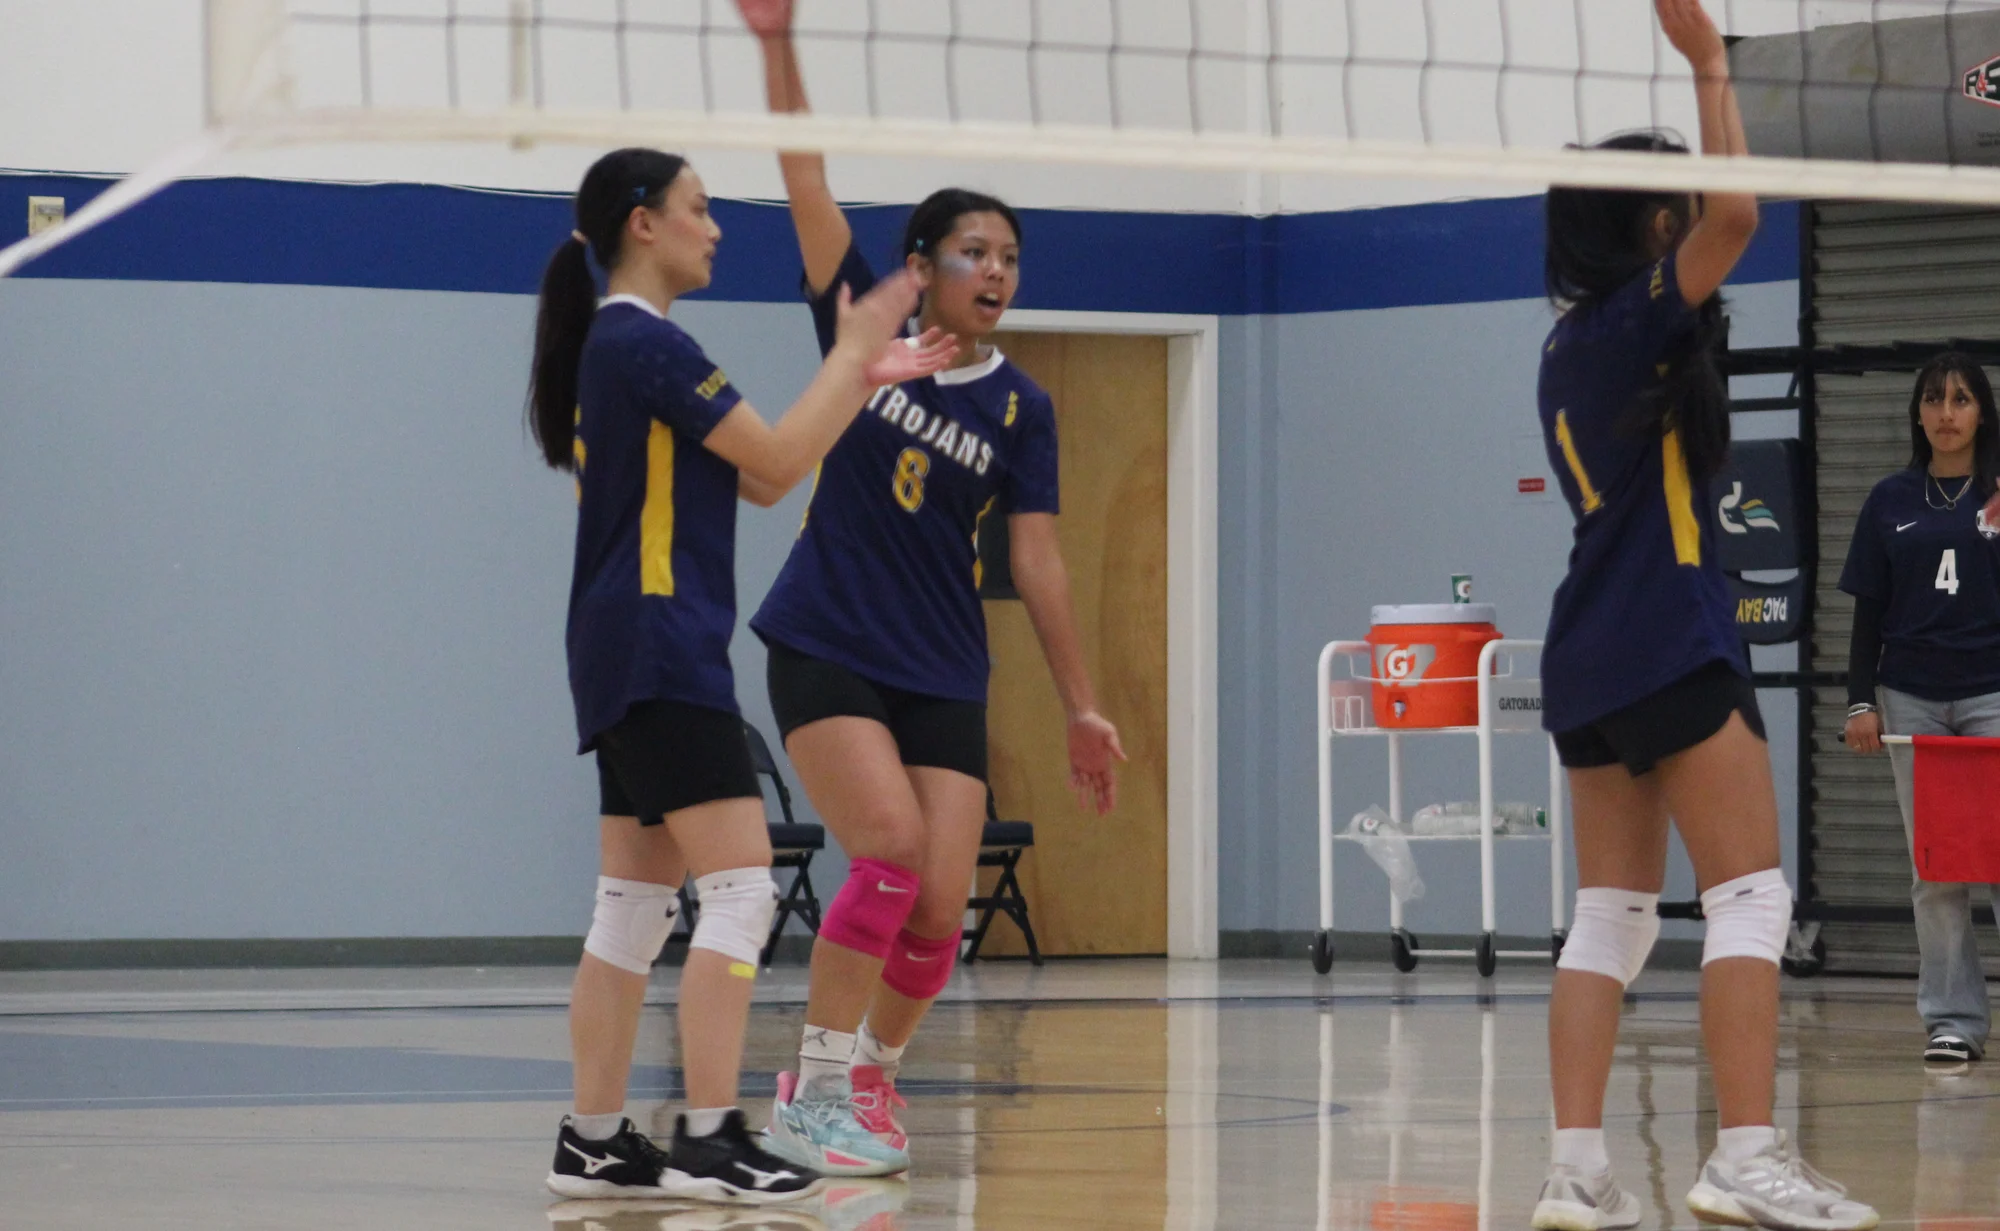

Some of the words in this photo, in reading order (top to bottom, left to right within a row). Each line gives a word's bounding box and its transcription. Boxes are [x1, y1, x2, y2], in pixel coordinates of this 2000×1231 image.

[867, 384, 994, 475] TROJANS
[1555, 408, 1604, 514] 1
[892, 447, 930, 514] 6
[1936, 549, 1959, 595] 4
[1387, 649, 1409, 677] G
